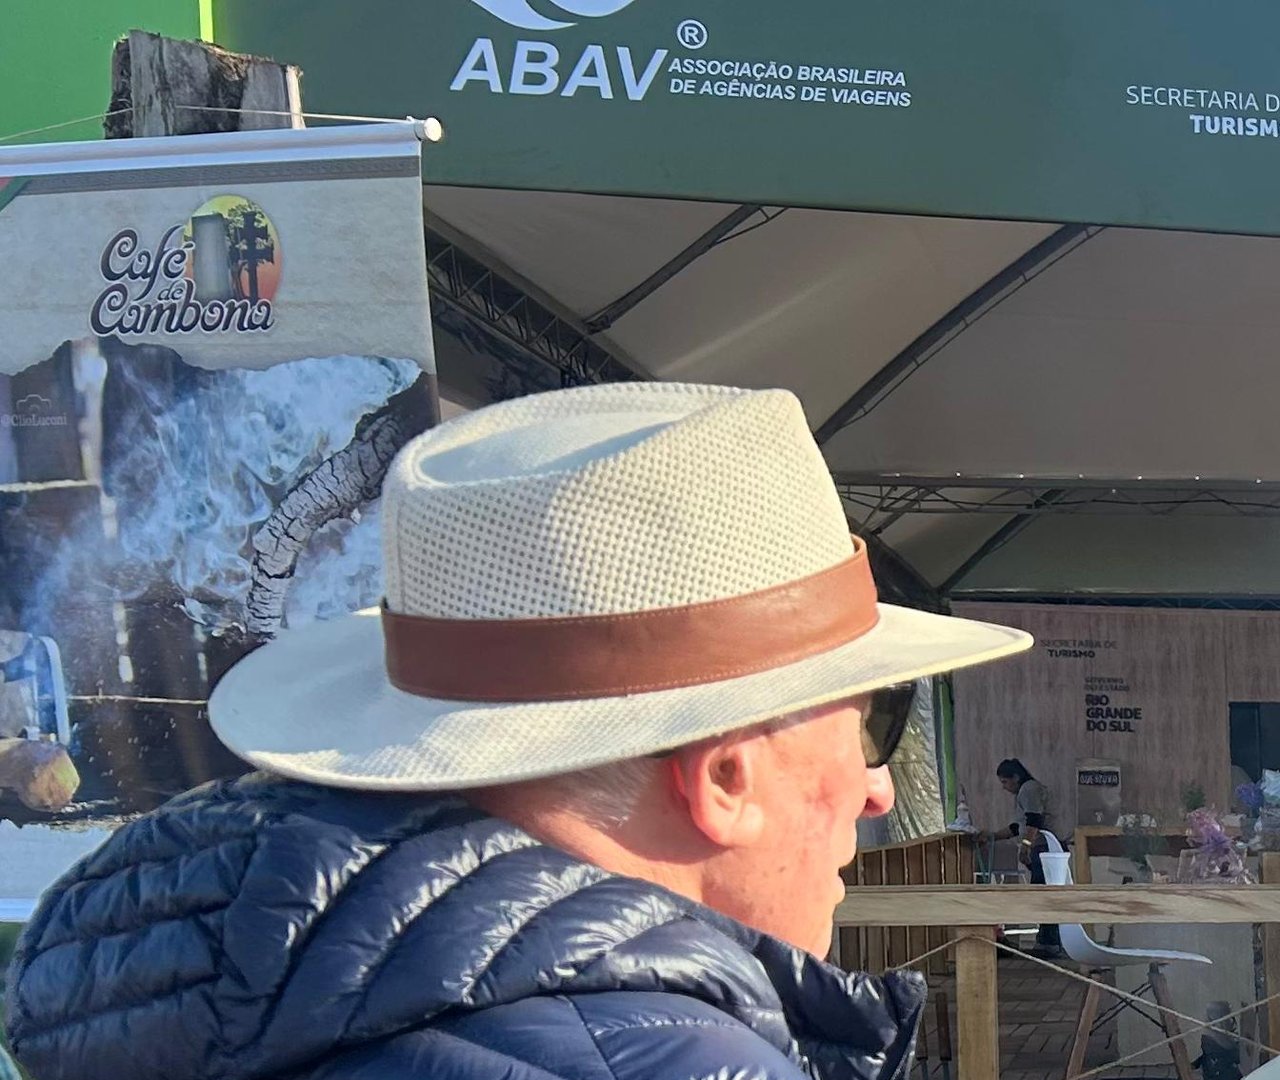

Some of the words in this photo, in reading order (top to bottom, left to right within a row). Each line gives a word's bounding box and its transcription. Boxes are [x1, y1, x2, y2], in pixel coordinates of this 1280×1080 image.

[450, 37, 669, 101] ABAV
[668, 58, 794, 82] ASSOCIAÇÃO
[796, 65, 906, 87] BRASILEIRA
[670, 78, 697, 95] DE
[699, 76, 796, 100] AGÊNCIAS
[800, 85, 827, 101] DE
[831, 88, 911, 107] VIAGENS
[1125, 85, 1261, 111] SECRETARIA
[100, 223, 195, 303] Café
[156, 279, 184, 302] de
[89, 278, 276, 336] Cambona
[1040, 639, 1102, 649] SECRETARIA
[1047, 648, 1096, 658] TURISMO
[1085, 694, 1110, 706] RIO
[1086, 707, 1142, 720] GRANDE
[1086, 719, 1107, 732] DO
[1108, 720, 1135, 733] SUL
